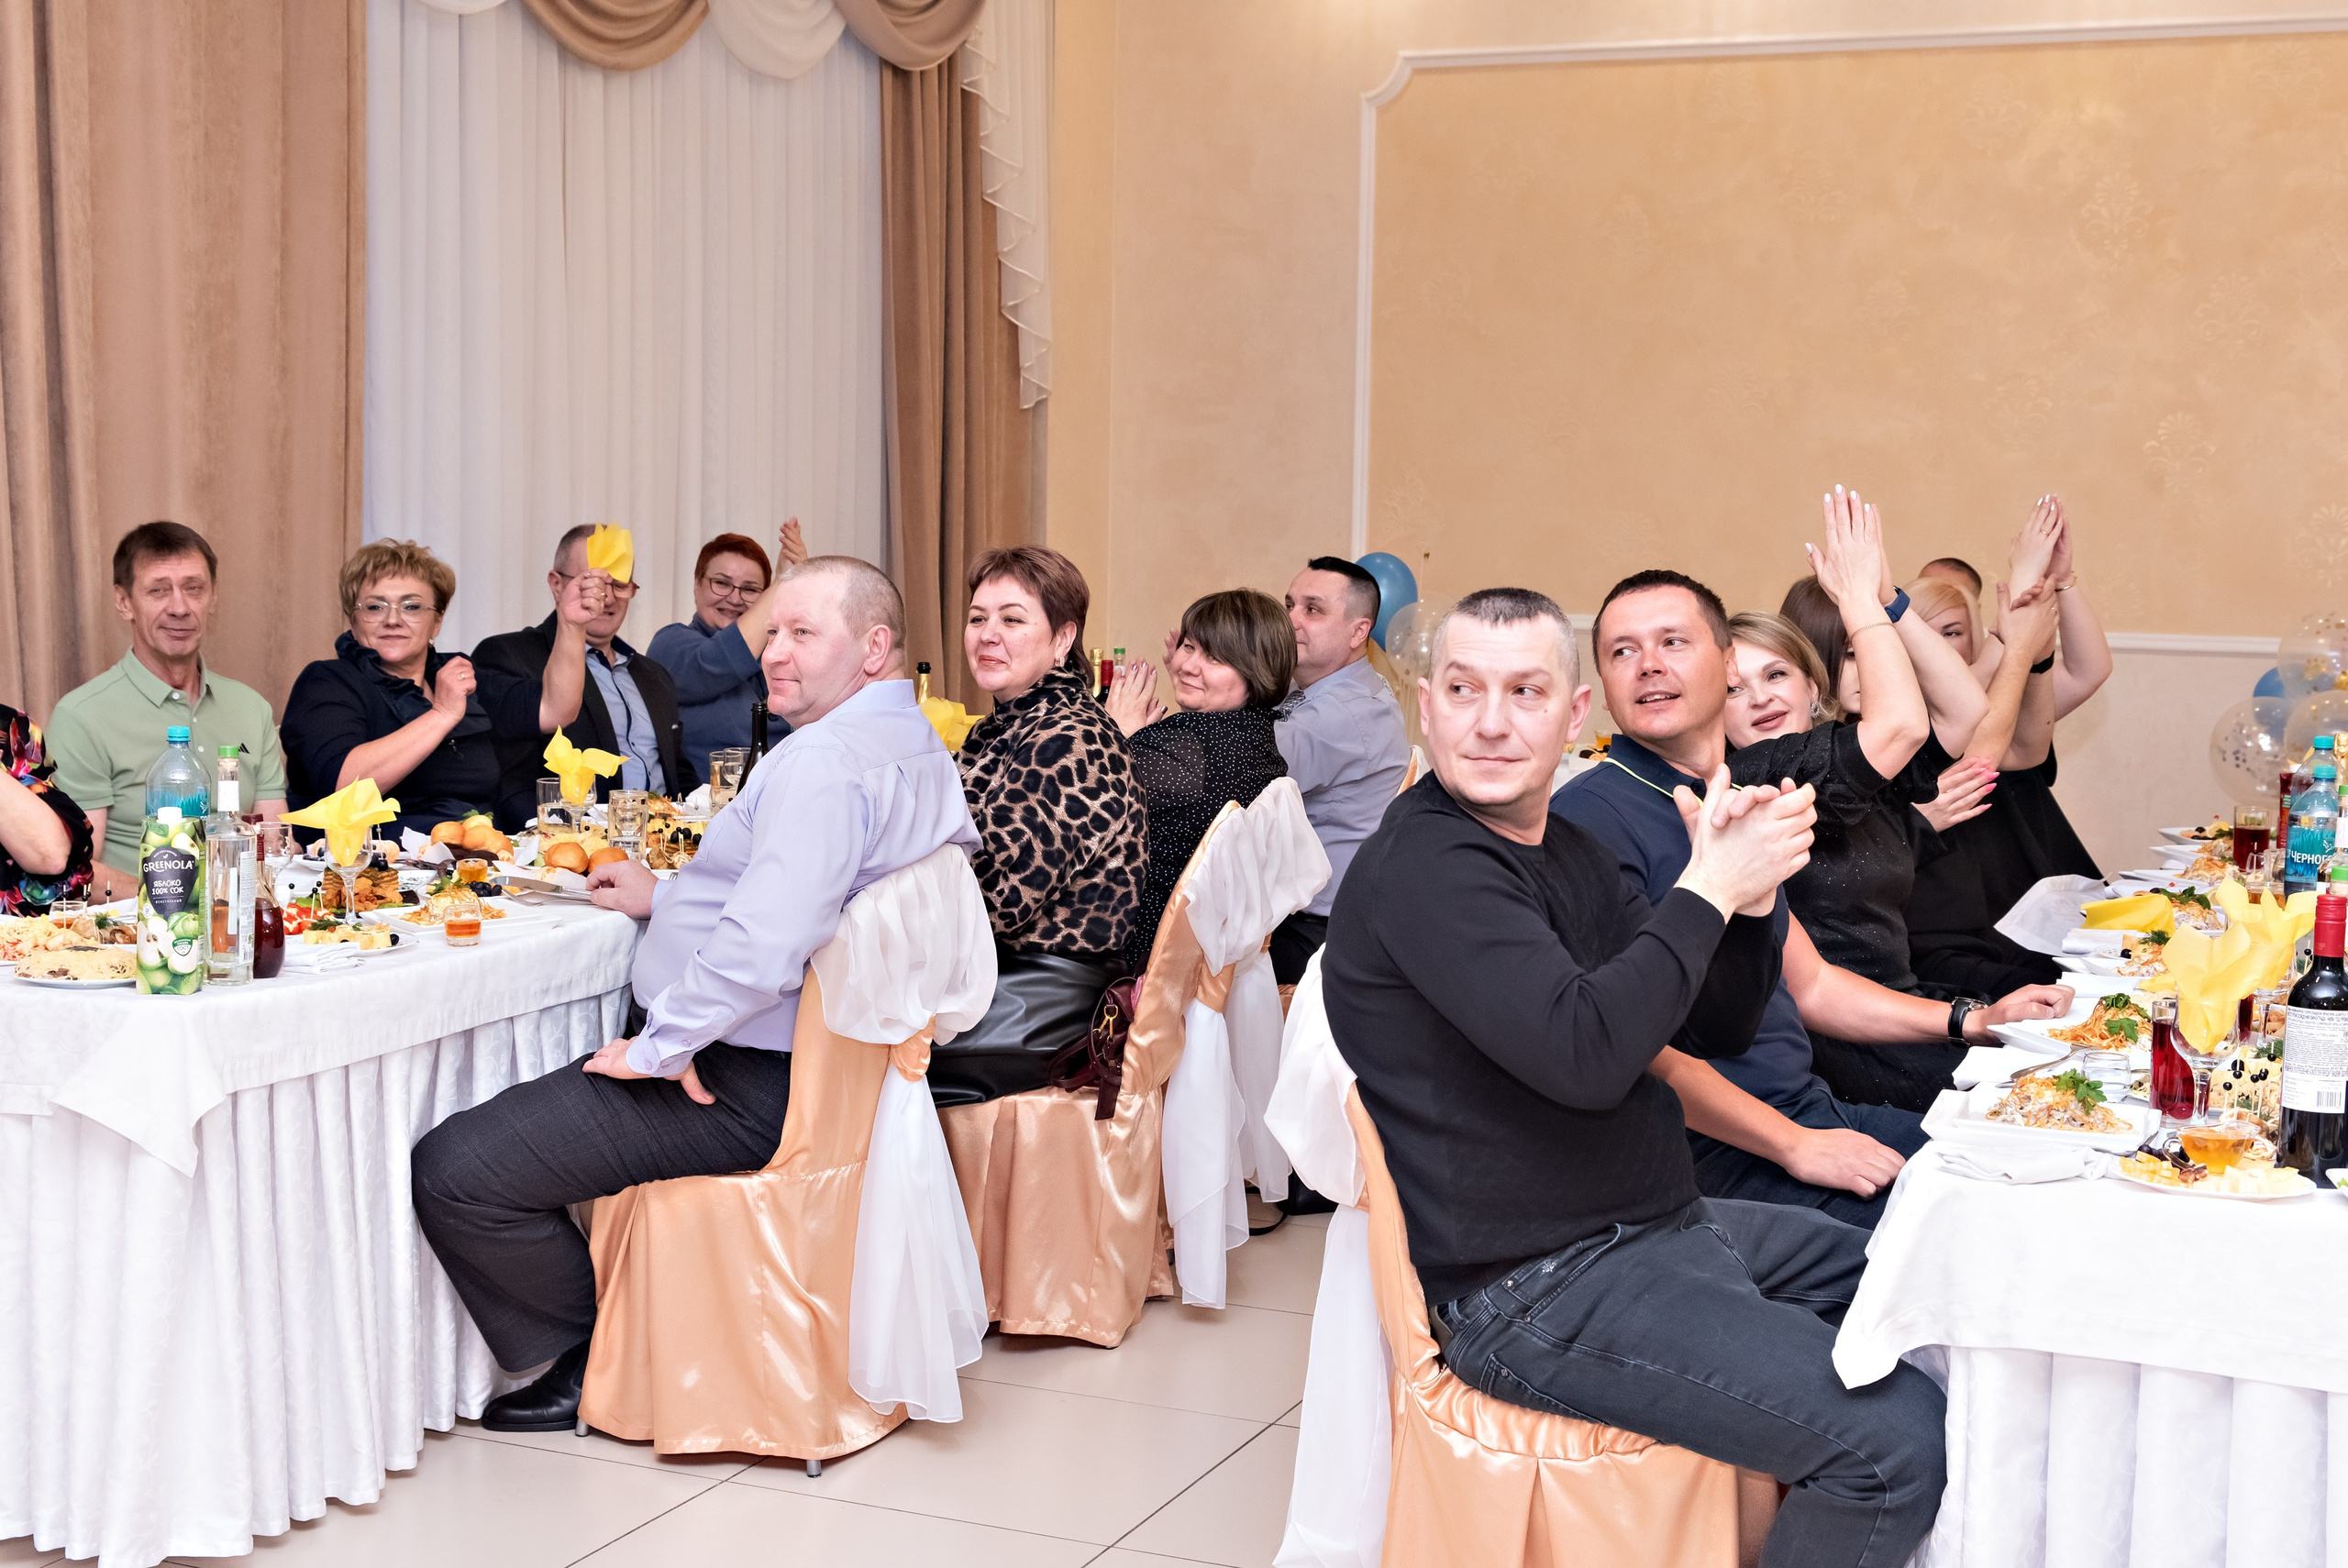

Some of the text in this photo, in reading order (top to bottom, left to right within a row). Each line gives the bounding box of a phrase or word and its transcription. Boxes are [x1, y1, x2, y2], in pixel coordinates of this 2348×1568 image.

[2291, 850, 2332, 865] ЧЕРНОГ
[143, 860, 194, 873] GREENOLA
[153, 878, 182, 888] ЯБЛОКО
[151, 886, 184, 895] 100% СОК
